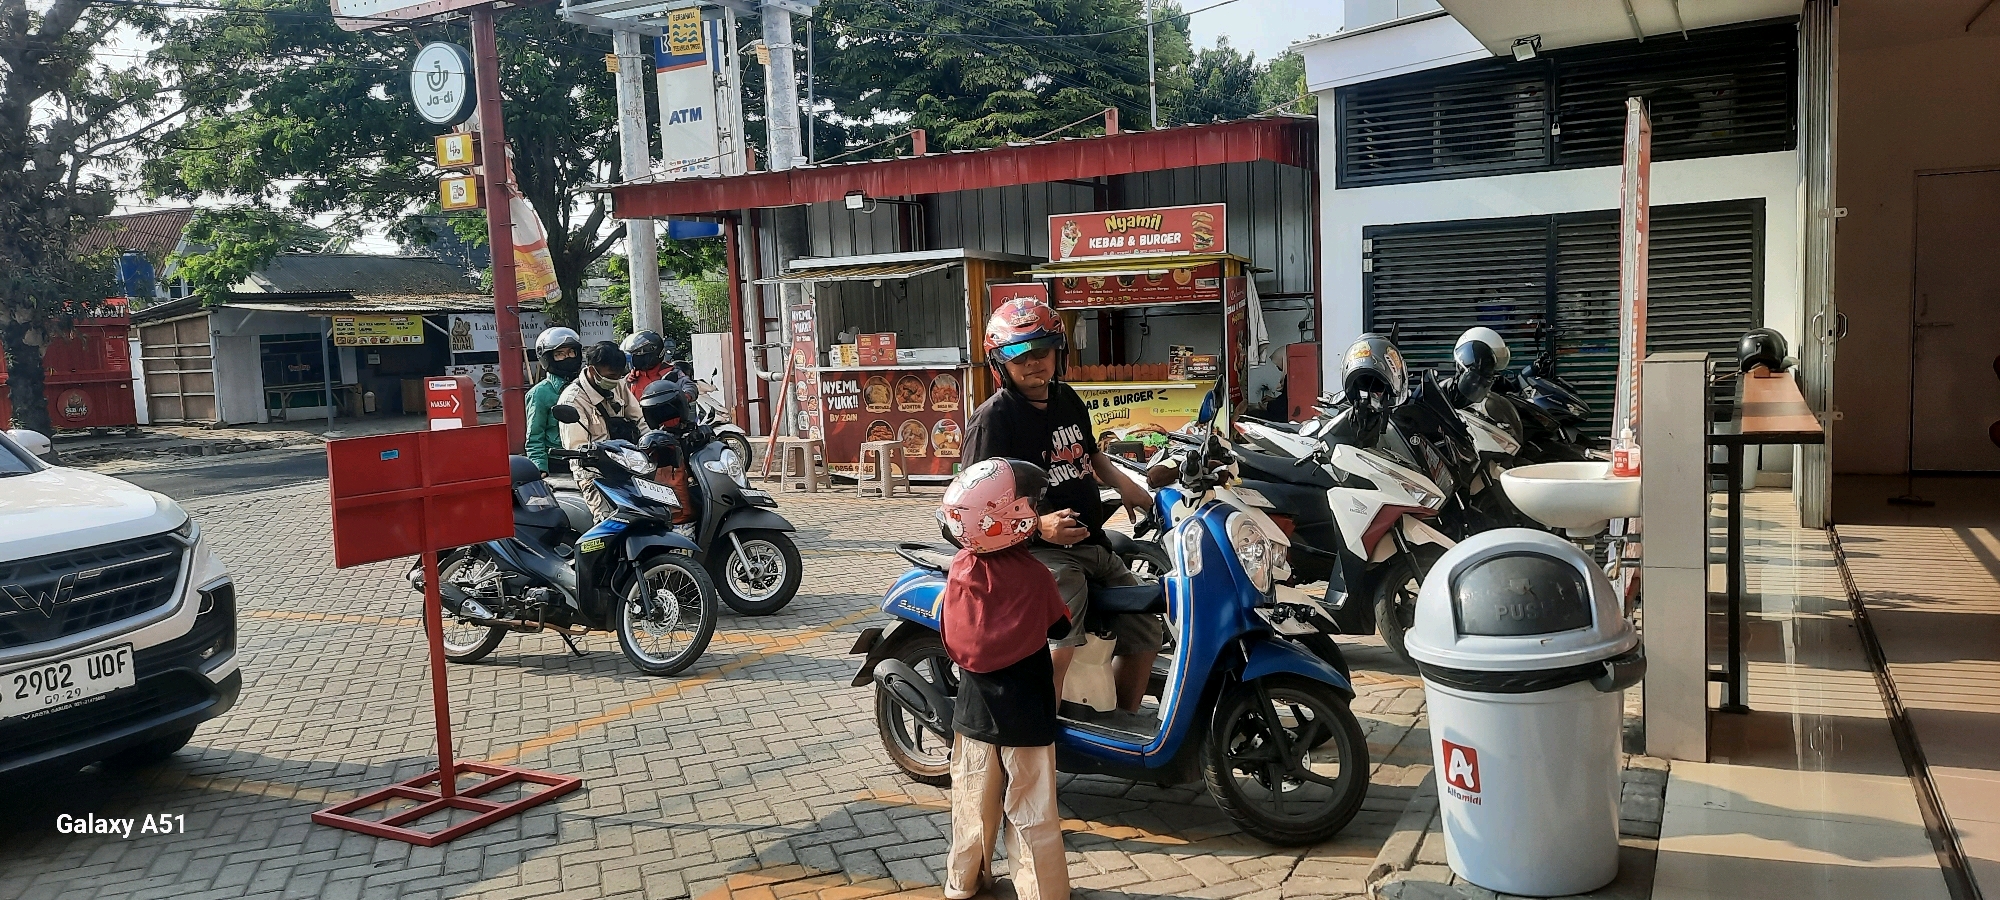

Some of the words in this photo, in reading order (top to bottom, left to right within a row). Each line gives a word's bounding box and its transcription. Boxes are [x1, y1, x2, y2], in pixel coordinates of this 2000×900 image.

[426, 90, 454, 107] Ja-di
[668, 106, 703, 126] ATM
[1104, 213, 1163, 235] Nyamil
[1089, 236, 1124, 249] KEBAB
[1127, 235, 1136, 247] &
[1139, 232, 1182, 246] BURGER
[822, 379, 861, 395] NYEMIL
[430, 400, 451, 408] MASUK
[827, 394, 859, 411] YUKK!!
[1102, 397, 1110, 408] &
[1113, 390, 1154, 406] BURGER
[829, 413, 839, 422] BY
[840, 413, 858, 422] ZAIN
[1093, 408, 1130, 425] Nyamil
[1494, 602, 1548, 621] PUS
[13, 663, 74, 700] 2902
[87, 649, 128, 680] UOF
